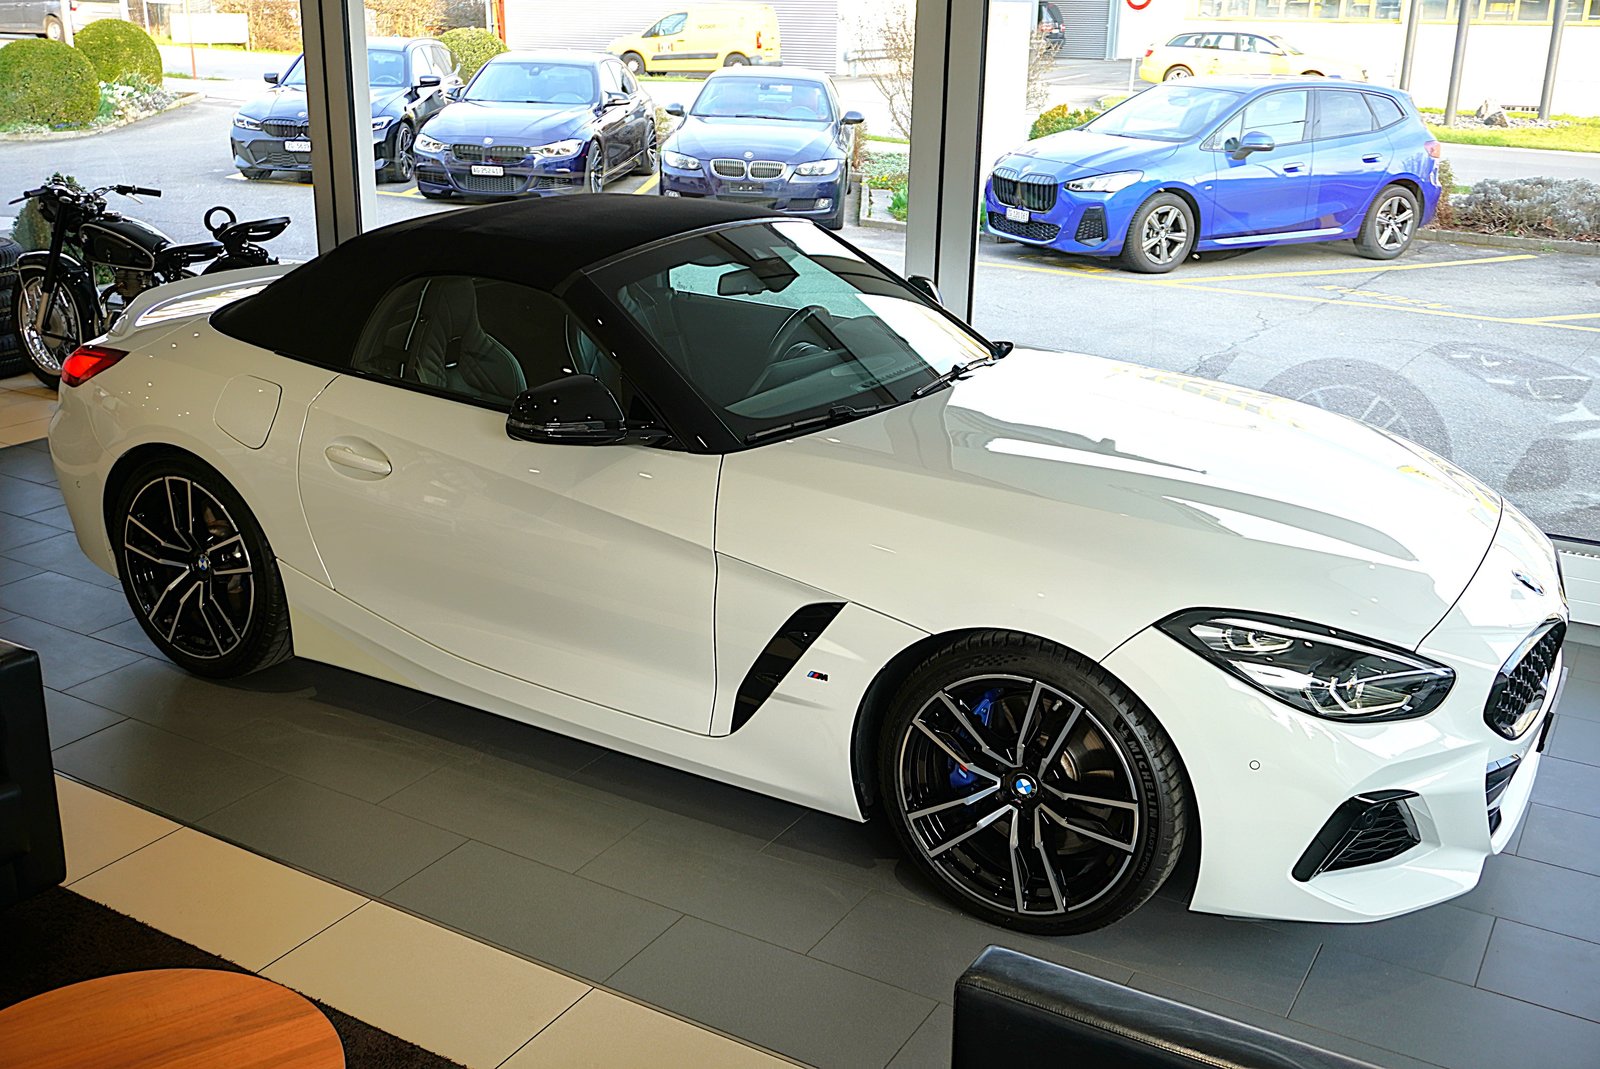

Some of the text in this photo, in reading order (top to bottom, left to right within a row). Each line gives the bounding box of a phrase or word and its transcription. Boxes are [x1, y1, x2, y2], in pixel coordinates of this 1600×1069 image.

[1127, 740, 1158, 818] MICHELIN
[1147, 826, 1157, 850] PILOT
[1137, 851, 1152, 877] SPORT
